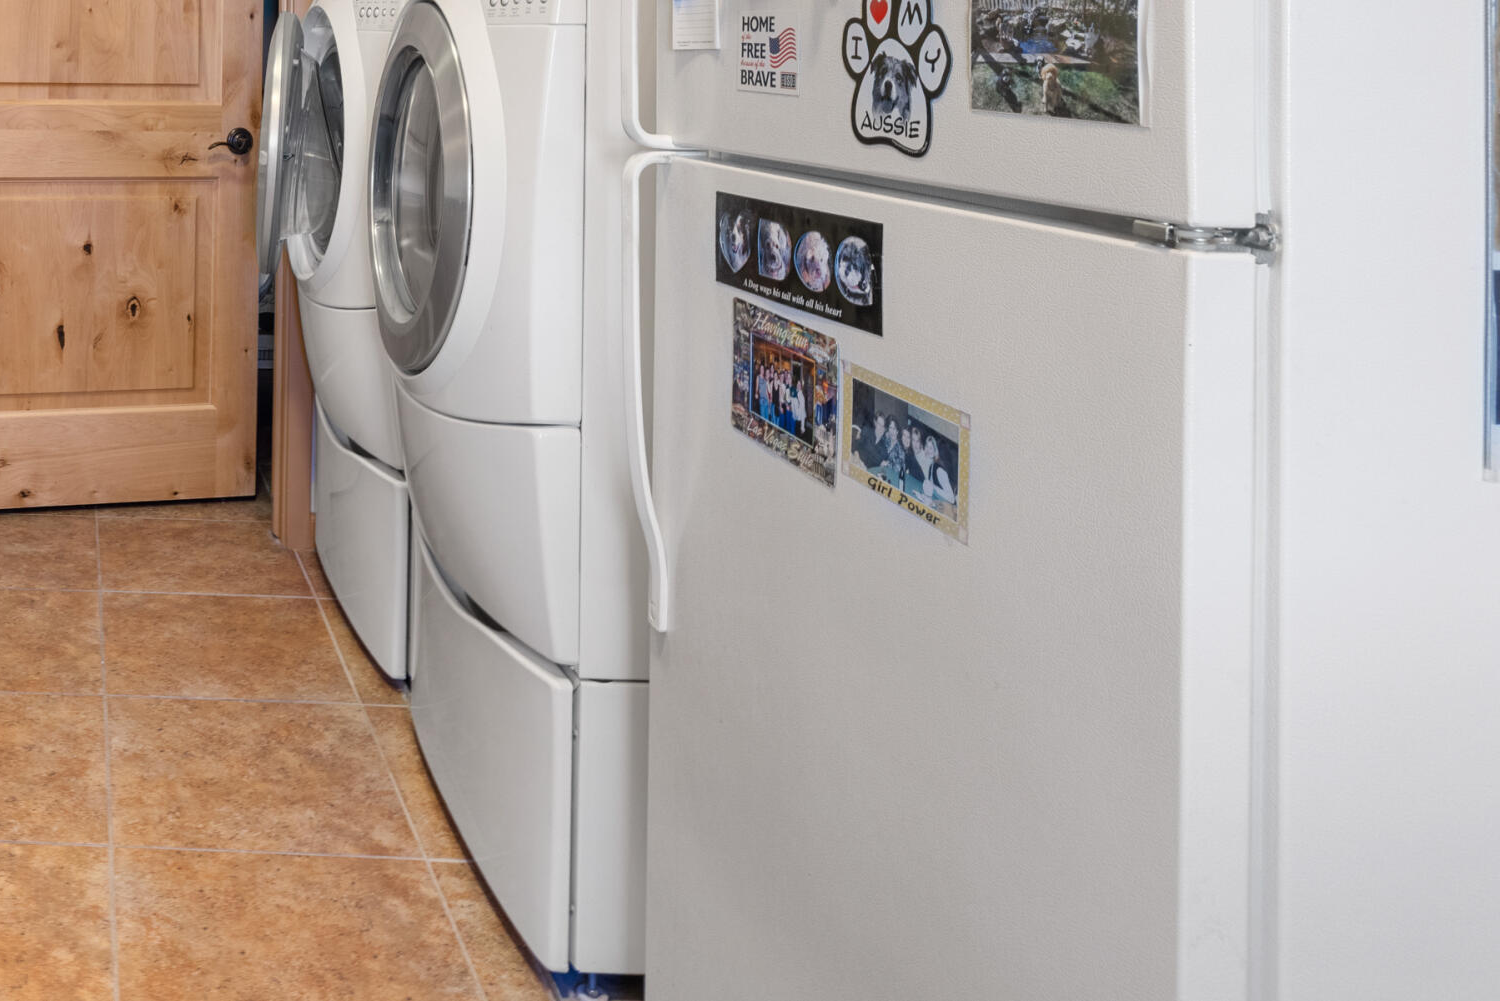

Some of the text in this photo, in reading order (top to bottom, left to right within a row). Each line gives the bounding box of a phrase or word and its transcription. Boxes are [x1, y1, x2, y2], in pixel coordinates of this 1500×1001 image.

[742, 15, 775, 32] HOME
[741, 42, 766, 59] FREE
[851, 36, 863, 60] I
[740, 69, 776, 88] BRAVE
[861, 110, 921, 139] AUSSIE
[748, 280, 759, 291] Dog
[759, 284, 772, 295] wags
[773, 288, 781, 298] his
[781, 291, 791, 301] tail
[792, 296, 805, 306] with
[805, 299, 814, 309] all
[814, 302, 824, 312] his
[825, 305, 842, 317] heart
[752, 312, 809, 349] Having Fun
[764, 426, 788, 450] Vegas
[867, 477, 941, 525] Girl Power
